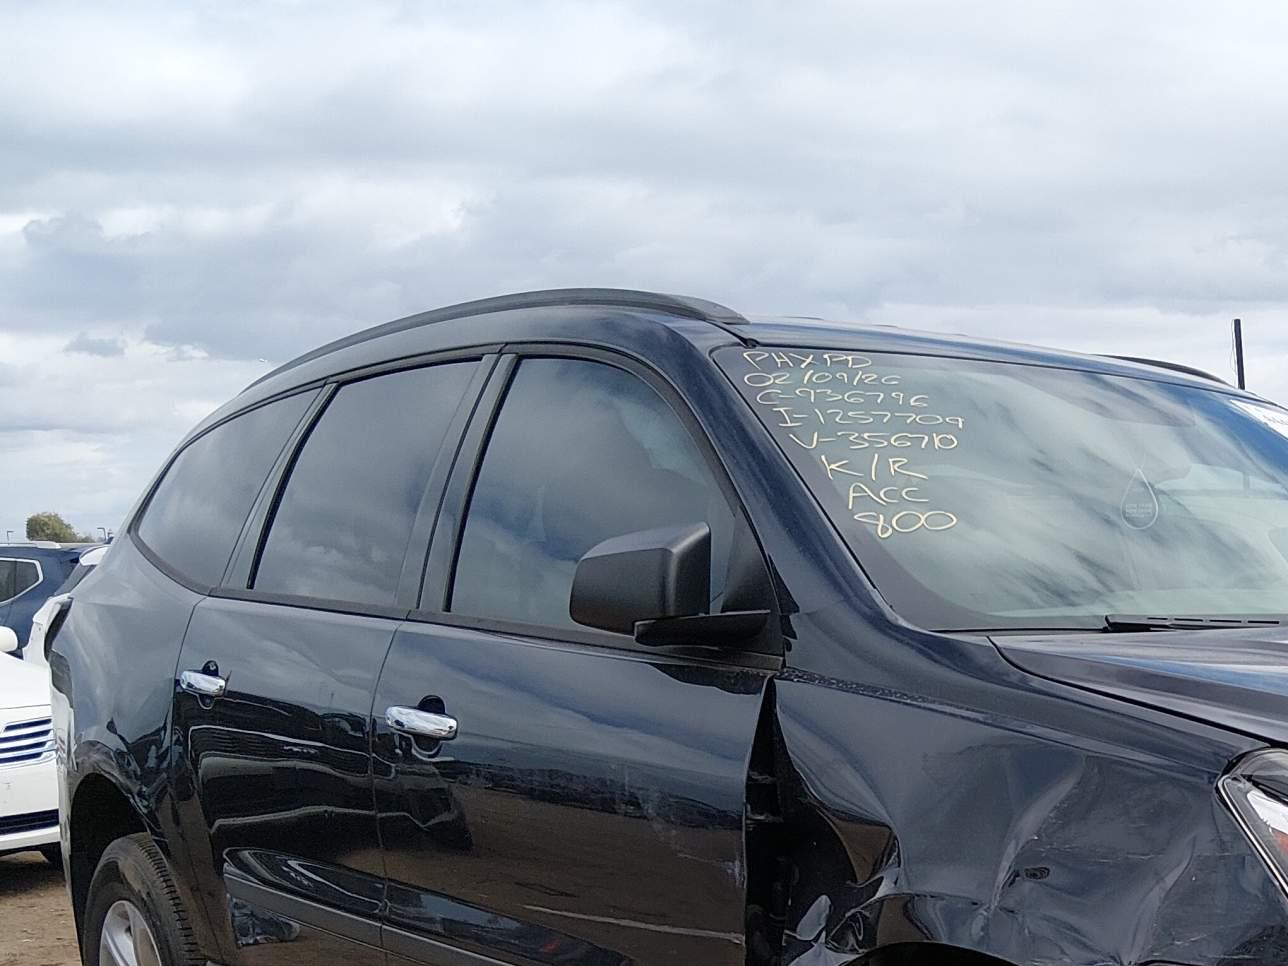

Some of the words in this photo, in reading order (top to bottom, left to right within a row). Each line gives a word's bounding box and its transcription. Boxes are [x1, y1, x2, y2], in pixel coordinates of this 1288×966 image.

[743, 351, 816, 371] PHX
[823, 352, 872, 369] PD
[756, 388, 929, 408] C-936796
[789, 431, 959, 450] V-356710
[848, 482, 929, 510] ACC
[853, 510, 958, 538] 800
